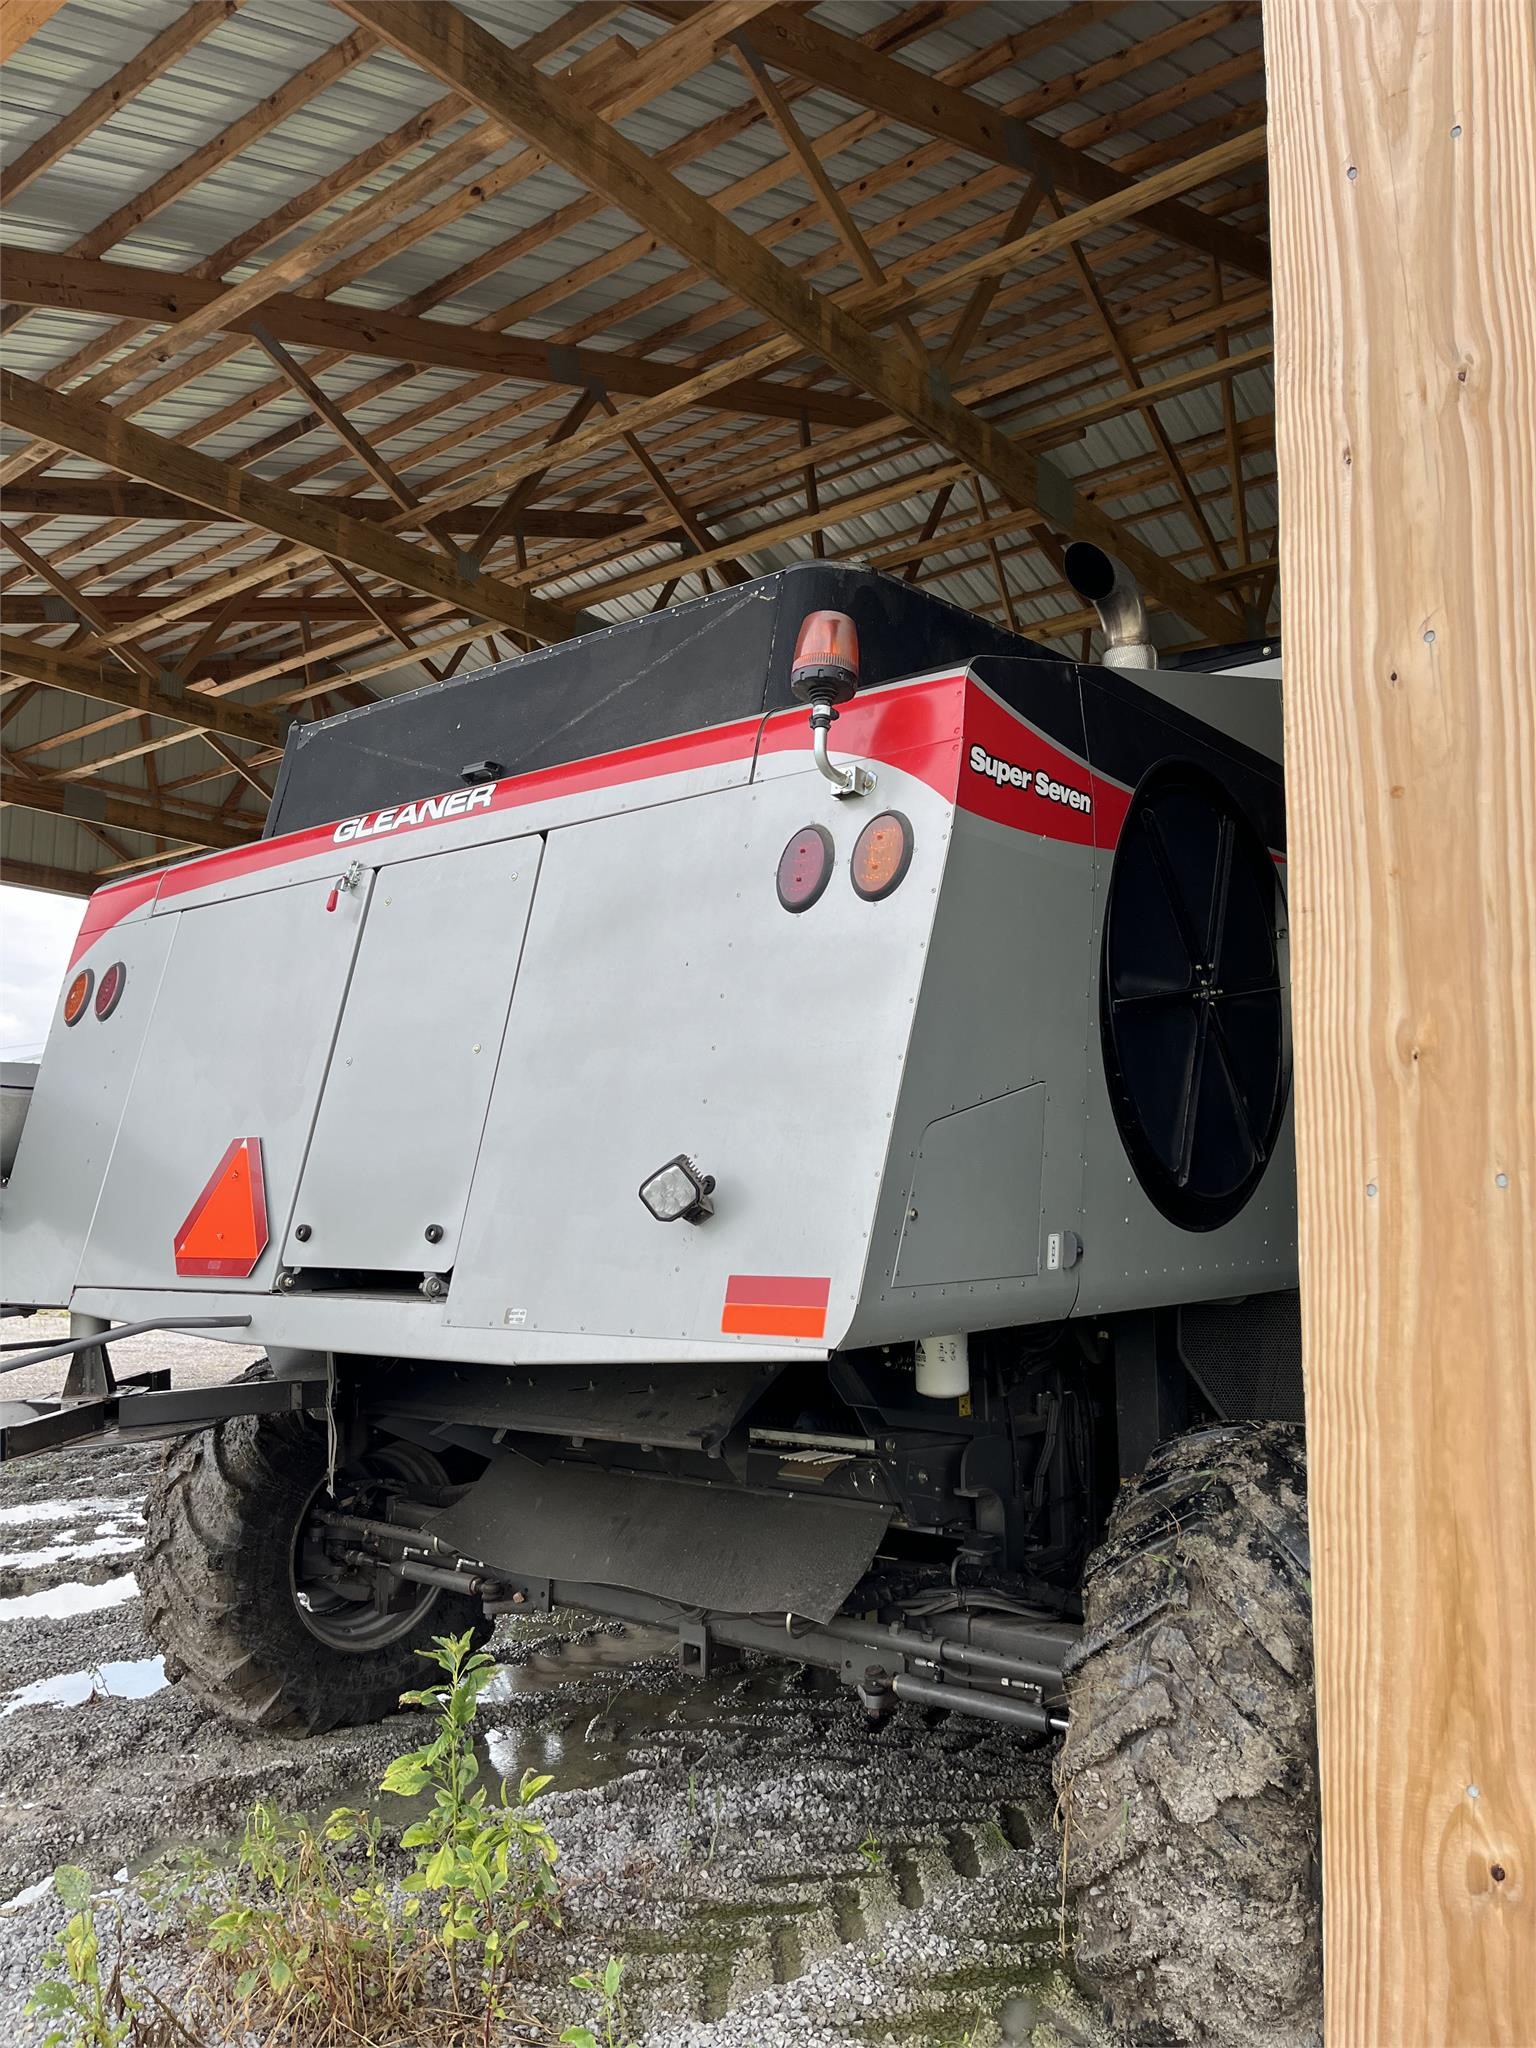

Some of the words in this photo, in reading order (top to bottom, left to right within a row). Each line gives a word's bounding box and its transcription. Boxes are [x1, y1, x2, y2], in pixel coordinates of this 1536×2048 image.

[969, 745, 1032, 789] Super
[1034, 771, 1092, 814] Seven
[332, 783, 498, 844] GLEANER
